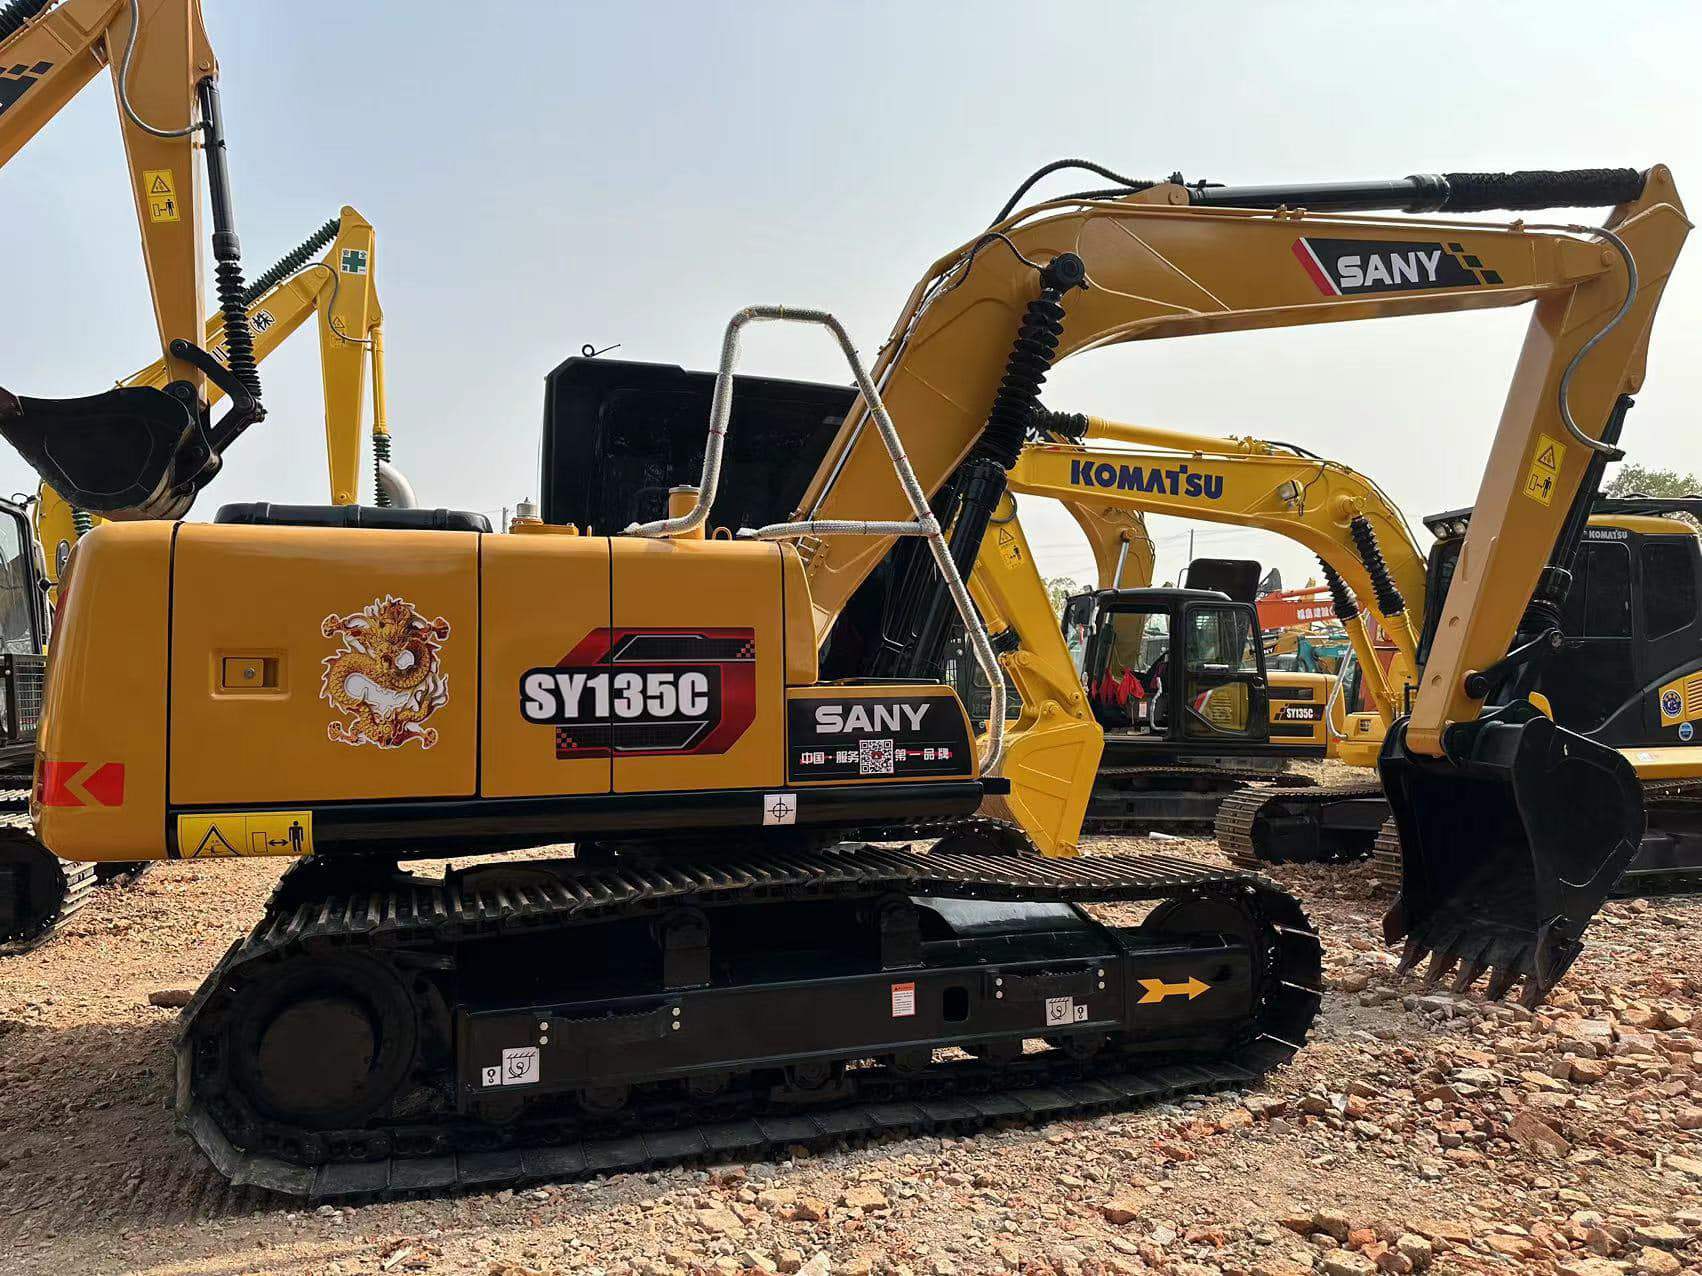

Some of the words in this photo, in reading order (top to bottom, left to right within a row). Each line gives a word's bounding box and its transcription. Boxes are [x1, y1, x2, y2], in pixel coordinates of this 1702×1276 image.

[1337, 250, 1441, 287] SANY
[1071, 459, 1223, 499] KOMATSU
[1588, 529, 1628, 540] KOMATSU
[525, 672, 708, 719] SY135C
[815, 704, 930, 733] SANY
[1286, 707, 1314, 719] SY135C
[895, 747, 950, 761] 第一品牌
